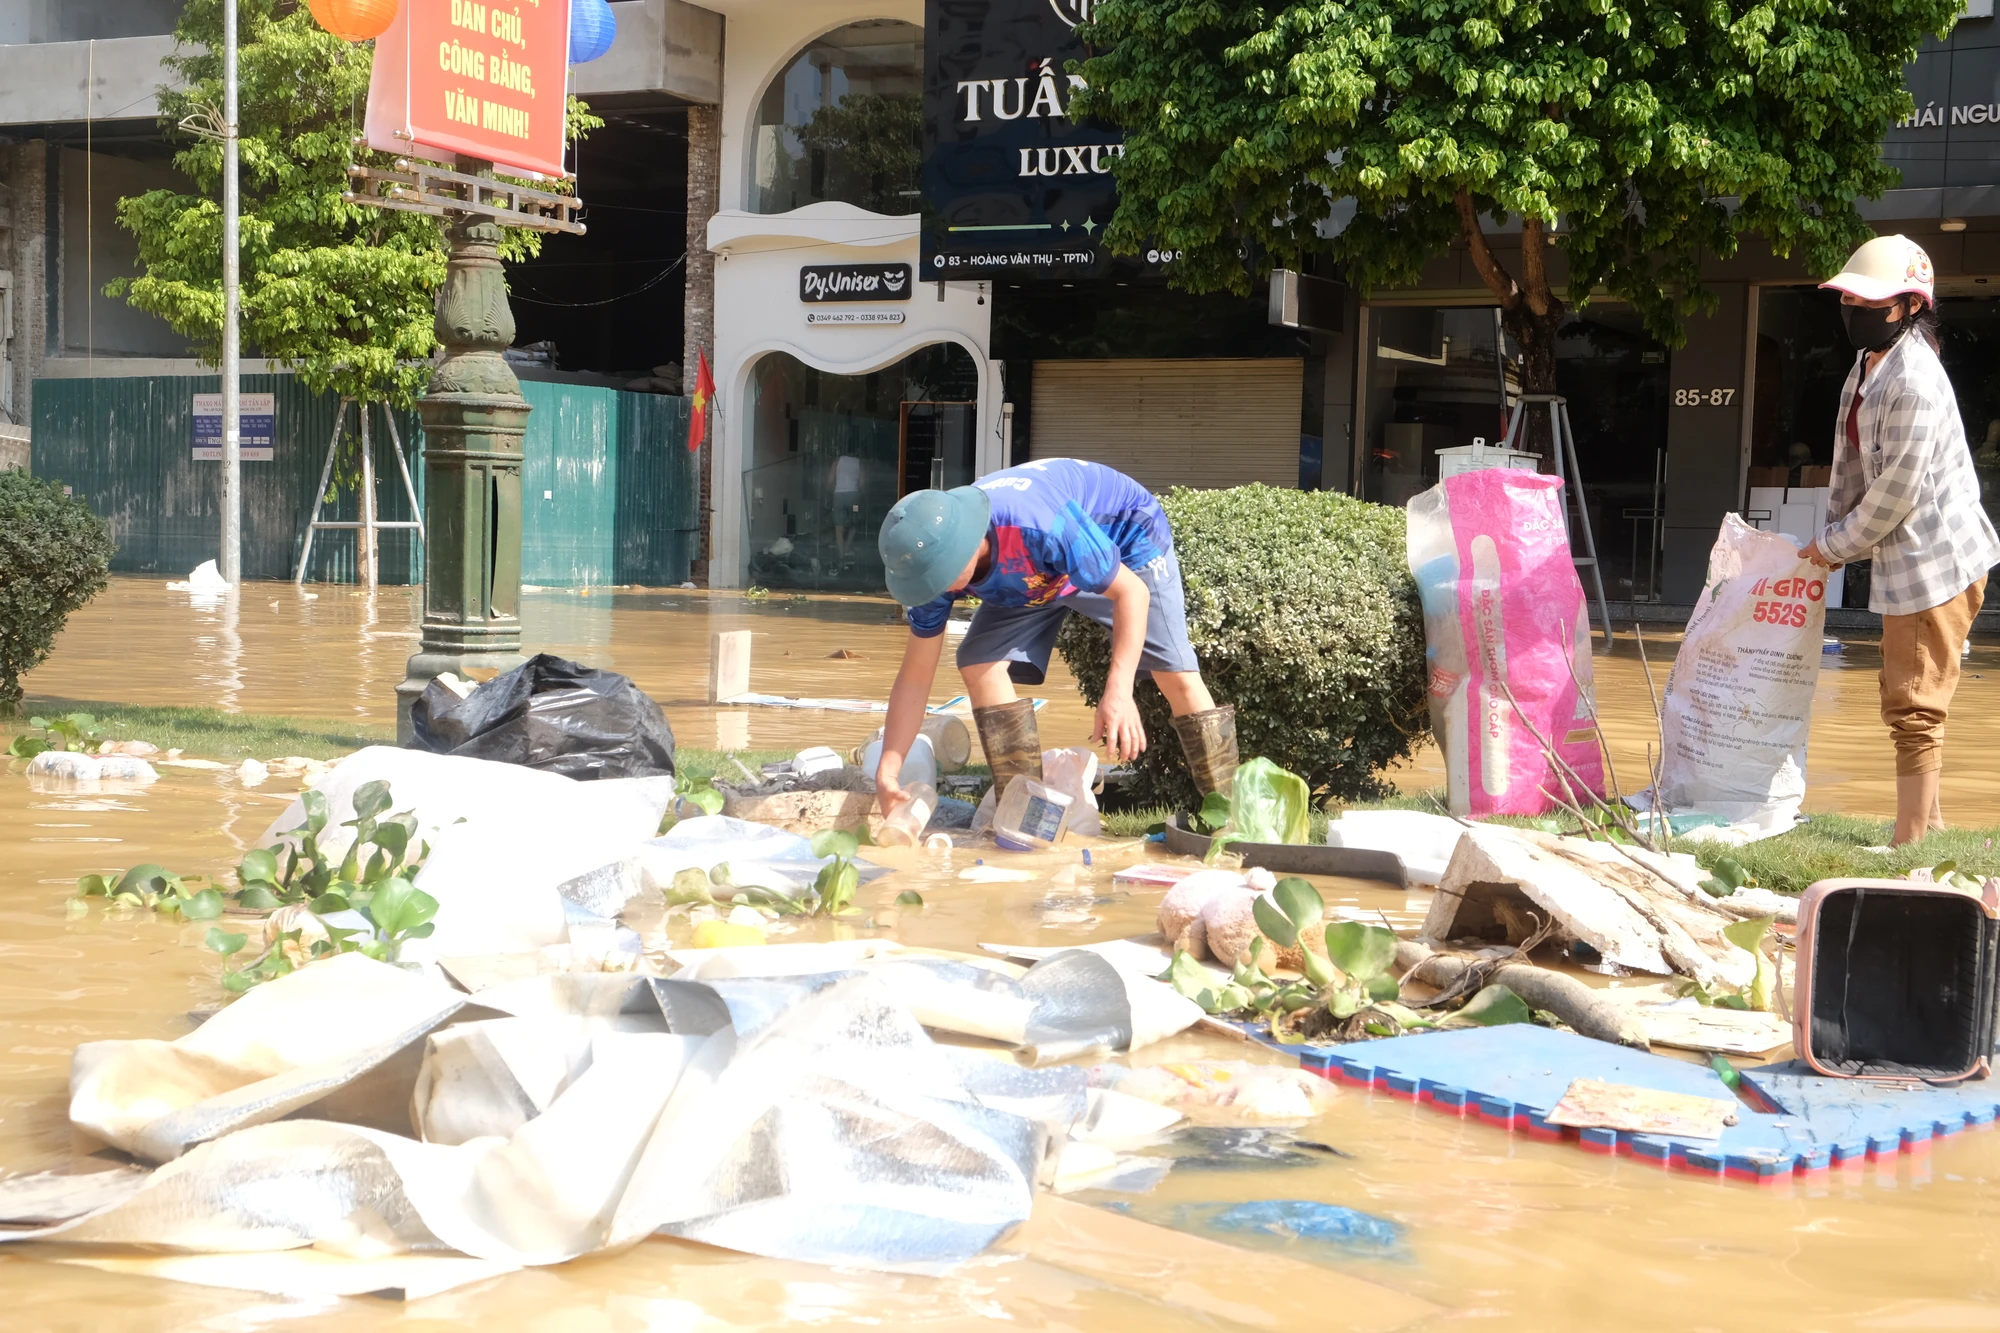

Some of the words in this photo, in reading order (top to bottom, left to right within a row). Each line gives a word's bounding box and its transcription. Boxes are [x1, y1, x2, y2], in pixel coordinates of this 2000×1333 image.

[491, 6, 526, 50] CHỦ,
[440, 38, 484, 81] CÔNG
[490, 48, 536, 99] BẰNG,
[444, 87, 478, 126] VĂN
[482, 100, 529, 140] MINH!
[948, 256, 960, 266] 83
[970, 253, 1008, 266] HOÀNG
[1010, 252, 1030, 264] VĂN
[1032, 253, 1052, 266] THỤ
[1063, 252, 1088, 264] TPTN
[804, 271, 880, 300] Dy.Unisex
[816, 314, 831, 322] 0349
[1675, 388, 1735, 406] 85-87
[1752, 602, 1808, 628] 552S
[1488, 683, 1498, 709] CAO
